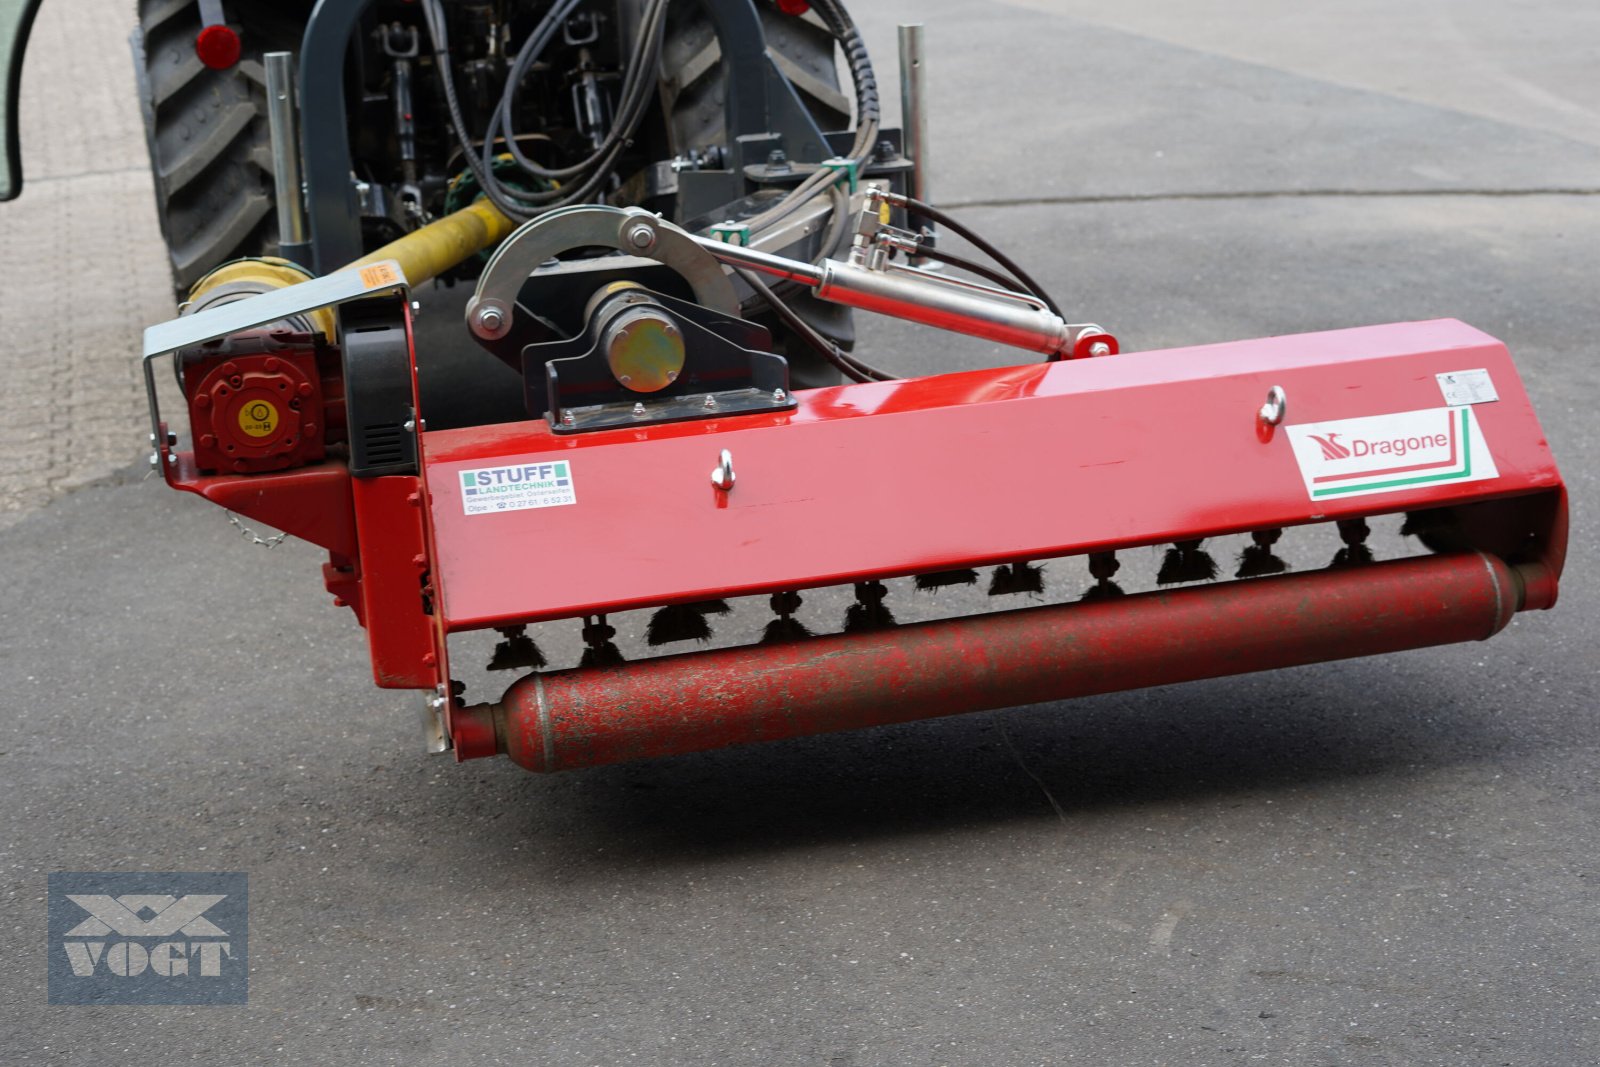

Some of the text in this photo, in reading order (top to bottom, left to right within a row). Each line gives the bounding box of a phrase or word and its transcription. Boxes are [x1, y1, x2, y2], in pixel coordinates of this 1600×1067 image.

[1352, 433, 1448, 457] Dragone
[477, 465, 552, 486] STUFF
[479, 480, 555, 494] LANDTECHNIK
